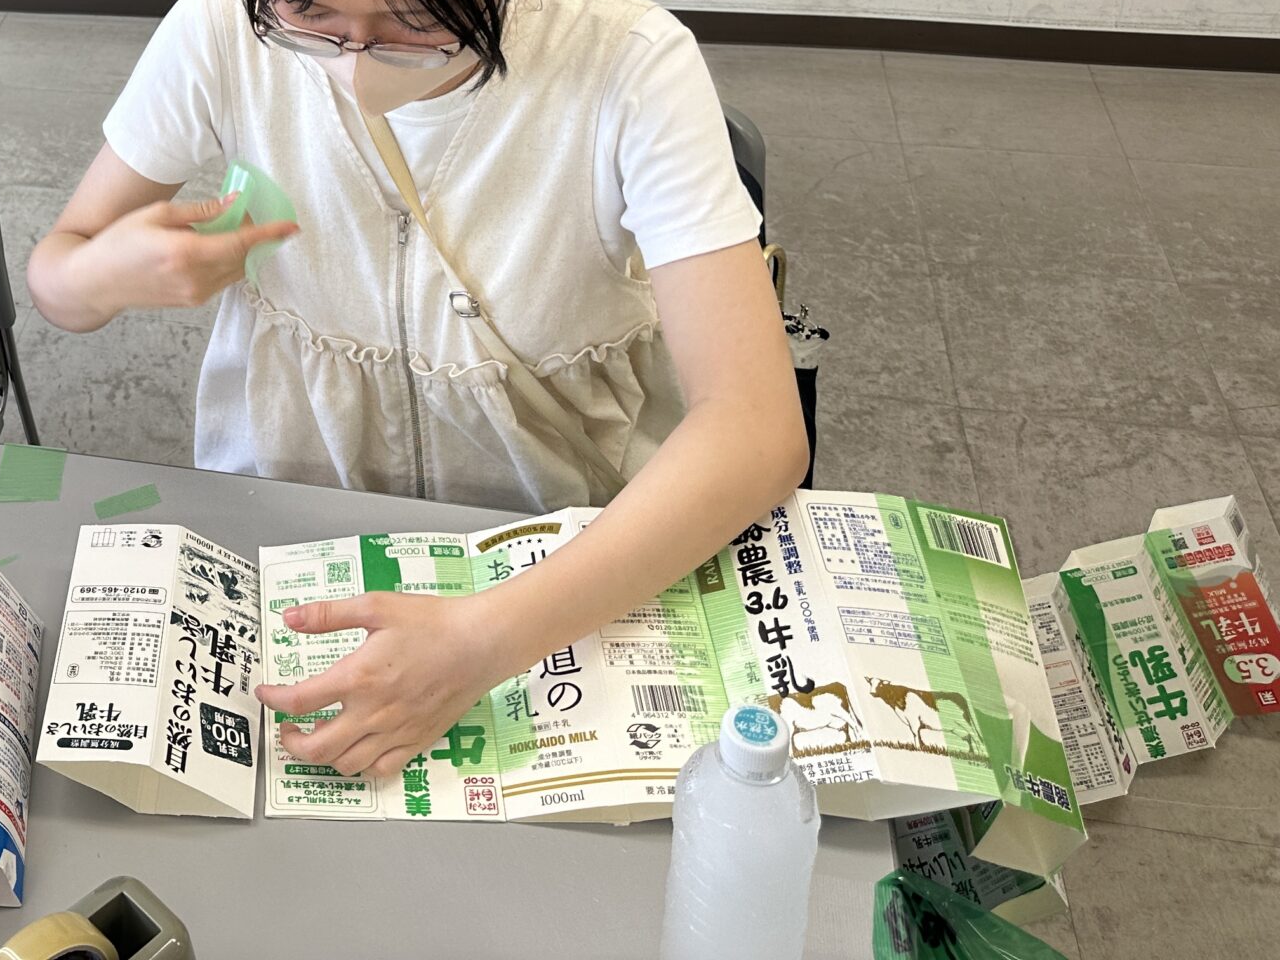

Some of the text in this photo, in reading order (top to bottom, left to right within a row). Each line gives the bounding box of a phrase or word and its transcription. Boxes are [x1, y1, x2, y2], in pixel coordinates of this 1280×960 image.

[184, 531, 214, 552] 1000ml
[771, 505, 803, 575] 成分無調整
[388, 546, 463, 557] 1000ml 要冷蔵
[79, 586, 146, 594] 0120-465-369
[1206, 588, 1227, 598] MILK
[1110, 613, 1154, 632] 成分無調整
[1200, 612, 1262, 640] 牛乳
[200, 623, 237, 697] 牛乳
[1128, 644, 1189, 721] 牛乳
[161, 613, 201, 774] 自然のおいしさ
[76, 702, 122, 722] 牛乳
[1112, 653, 1167, 759] 美濃せいきょう
[213, 711, 237, 725] 使用
[552, 719, 571, 729] 牛乳
[46, 722, 149, 738] 自然のおいしさ
[200, 719, 250, 748] 100%
[70, 739, 120, 749] 成分無調整
[509, 730, 598, 754] HOKKAIDO MILK
[215, 743, 239, 759] 生乳
[537, 749, 573, 761] 成分無調整
[816, 757, 852, 769] 8.3%以上
[281, 780, 367, 790] 美濃せいきょう牛乳
[645, 785, 676, 795] 要冷蔵
[287, 794, 362, 805] みんなで利用しよう
[540, 789, 585, 806] 1000ml
